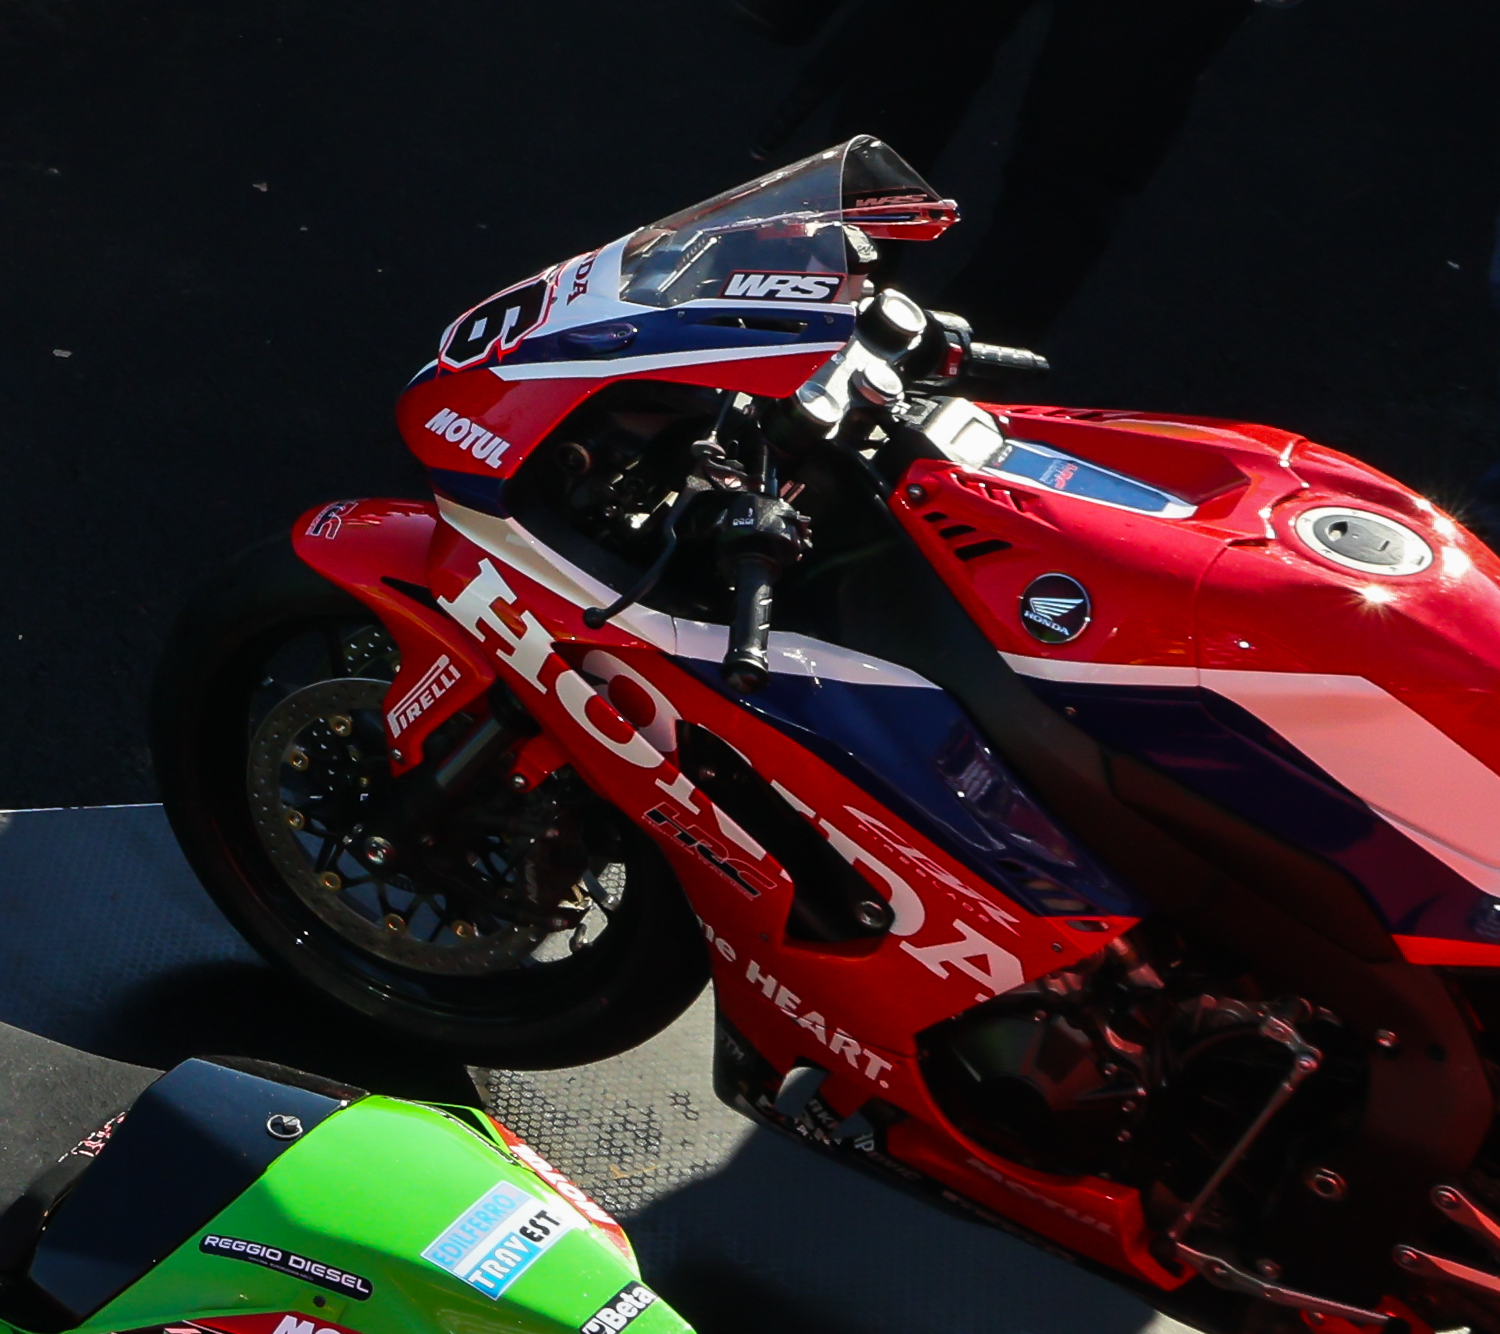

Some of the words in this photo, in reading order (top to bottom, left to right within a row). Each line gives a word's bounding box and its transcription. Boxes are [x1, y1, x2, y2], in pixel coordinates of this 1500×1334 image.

[723, 273, 842, 301] WRS
[424, 407, 512, 470] MOTUL
[1022, 610, 1071, 636] HONDA
[385, 655, 462, 739] PIRELLI
[745, 959, 893, 1091] HEART.
[204, 1232, 282, 1268] REGGIO
[288, 1252, 371, 1299] DIESEL
[468, 1206, 563, 1296] TRAVEST
[603, 1283, 658, 1332] Beta
